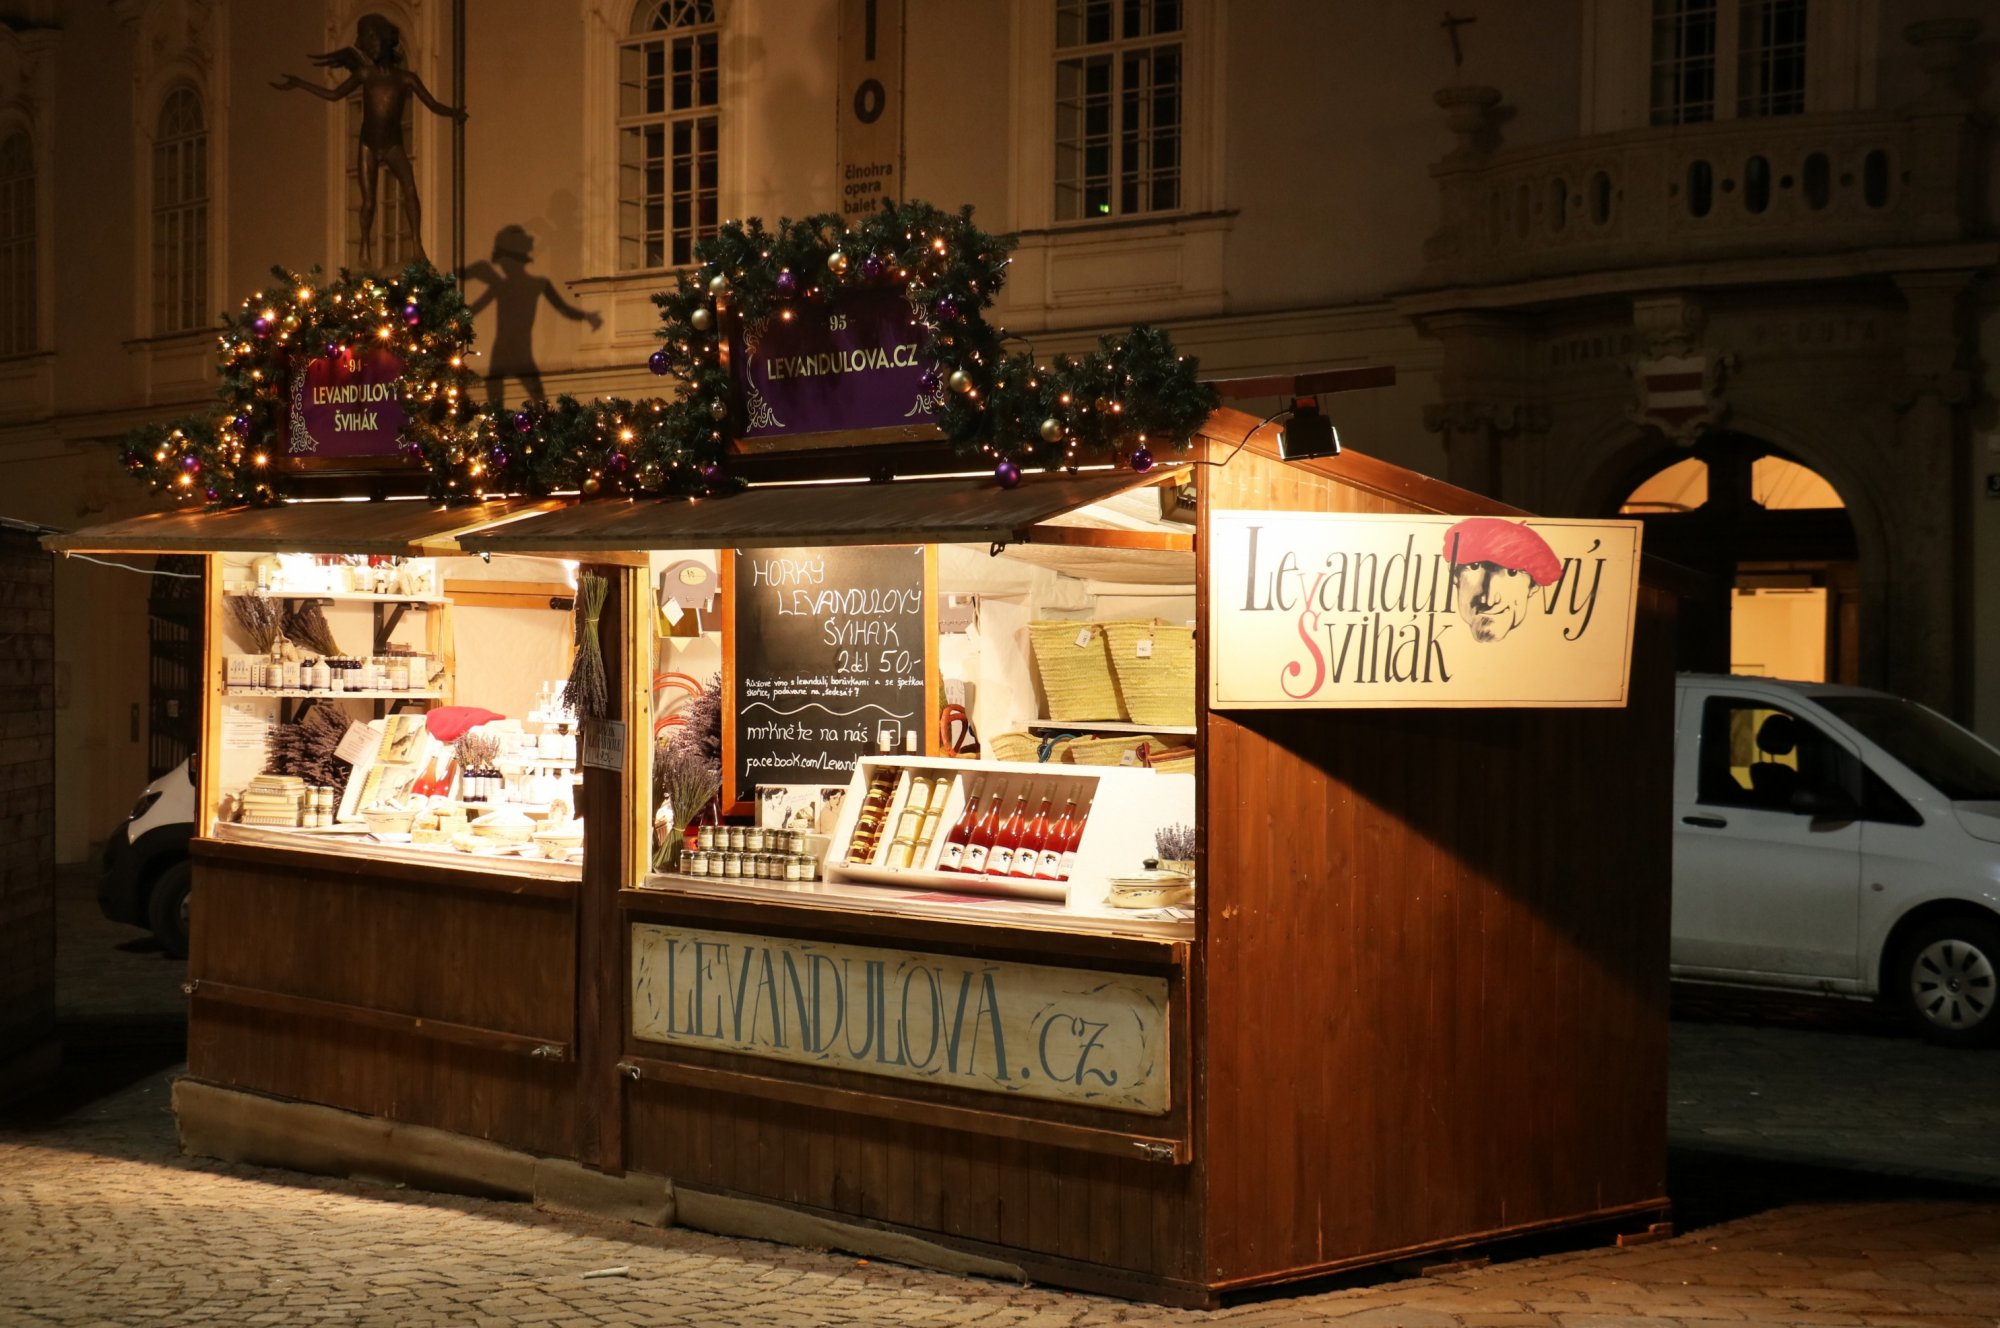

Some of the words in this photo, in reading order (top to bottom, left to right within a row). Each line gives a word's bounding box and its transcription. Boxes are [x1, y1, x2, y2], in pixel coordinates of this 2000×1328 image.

[844, 180, 882, 198] opera
[844, 197, 877, 215] balet
[829, 314, 847, 332] 95
[767, 343, 919, 381] LEVANDULOVA.CZ
[334, 408, 379, 432] ŠVIHÁK
[753, 554, 825, 587] HORKÝ
[777, 580, 922, 616] LEVANDULOVÝ
[823, 615, 900, 647] ŠVIHÁK
[820, 728, 839, 742] na
[844, 722, 869, 743] náš
